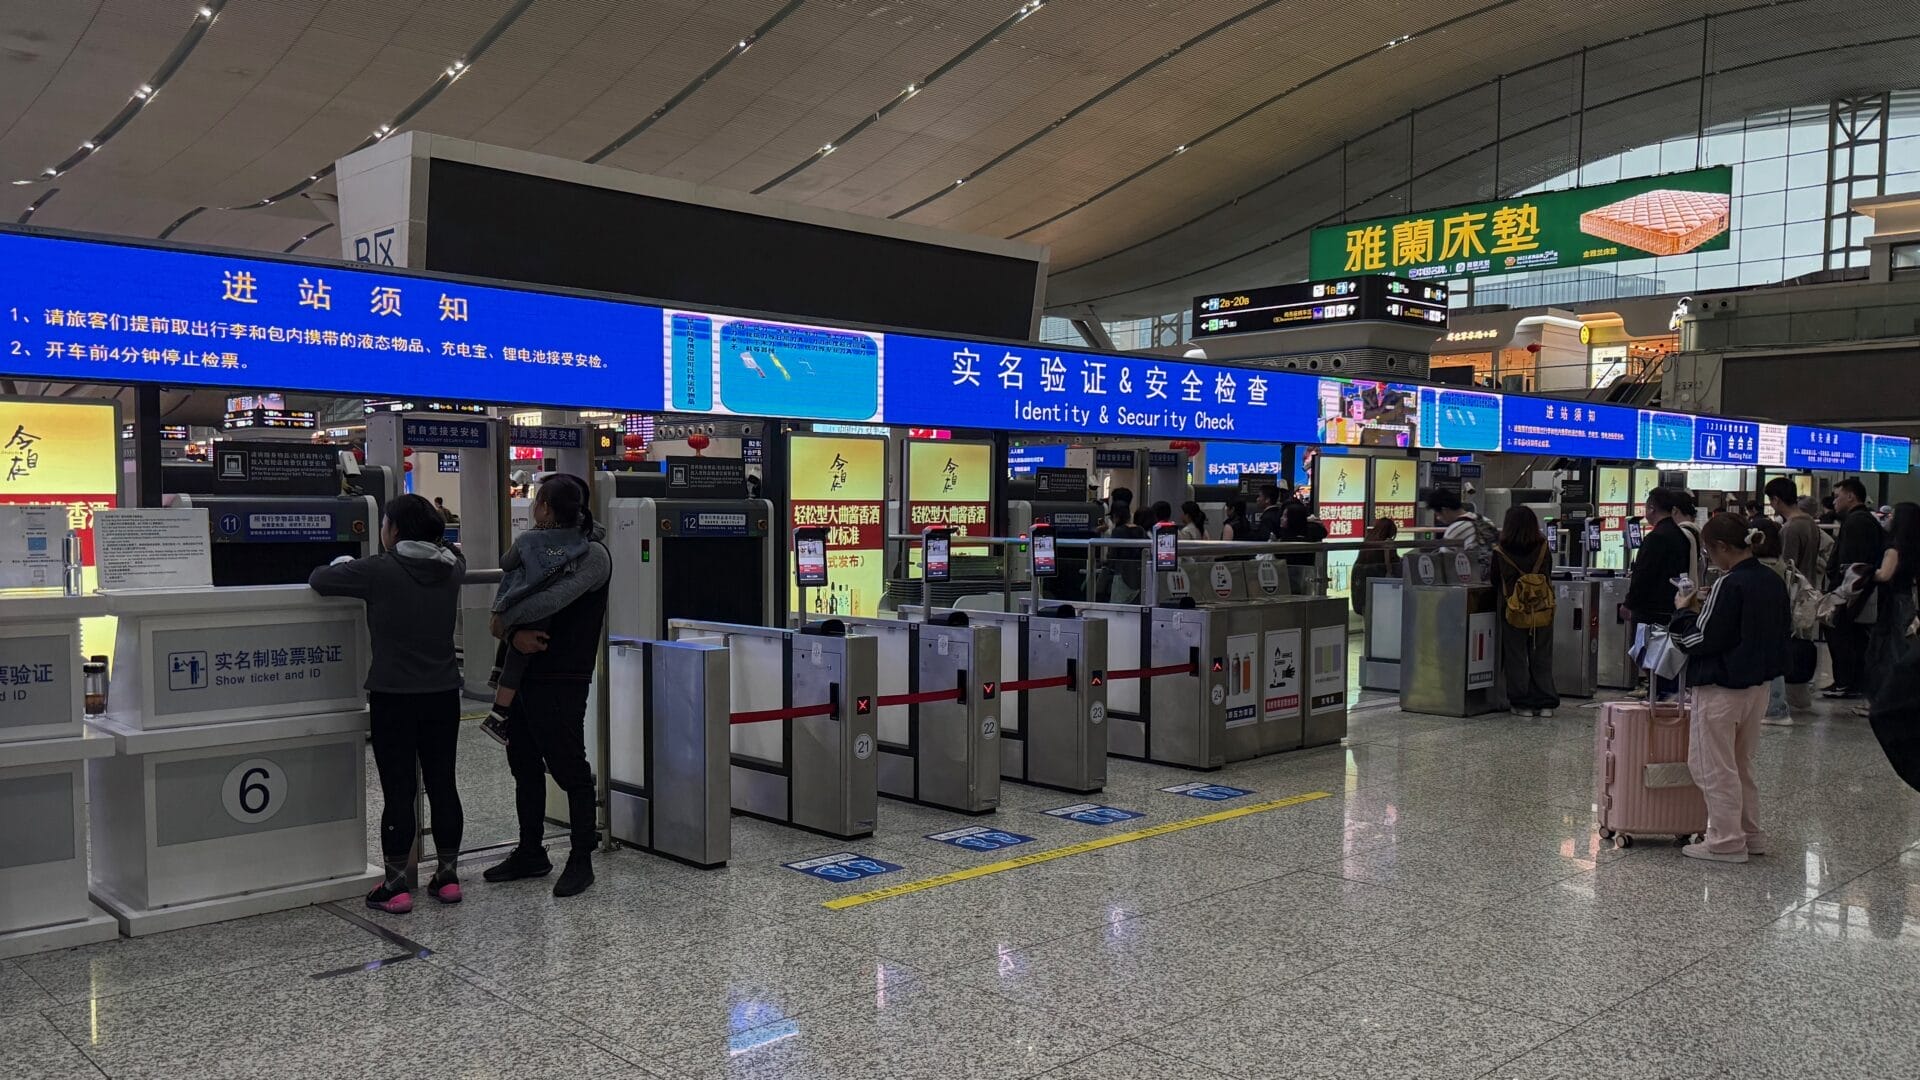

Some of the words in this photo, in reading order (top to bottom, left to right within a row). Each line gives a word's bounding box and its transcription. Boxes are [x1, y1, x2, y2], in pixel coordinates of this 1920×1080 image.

[1344, 204, 1541, 272] 雅蘭床墊
[1014, 400, 1091, 425] Identity
[1099, 409, 1109, 424] &
[1117, 410, 1187, 430] Security
[1194, 411, 1235, 431] Check
[1208, 462, 1281, 475] 科大讯飞AI学习
[223, 518, 237, 530] 11
[684, 517, 696, 529] 12
[215, 645, 343, 670] 实名制验票验证
[215, 673, 245, 686] Show
[250, 671, 280, 684] ticket
[284, 669, 304, 681] and
[308, 668, 321, 679] ID
[13, 689, 27, 701] ID
[1213, 690, 1222, 701] 24
[1092, 707, 1103, 719] 23
[983, 722, 995, 734] 22
[857, 740, 869, 753] 21
[238, 767, 270, 814] 6
